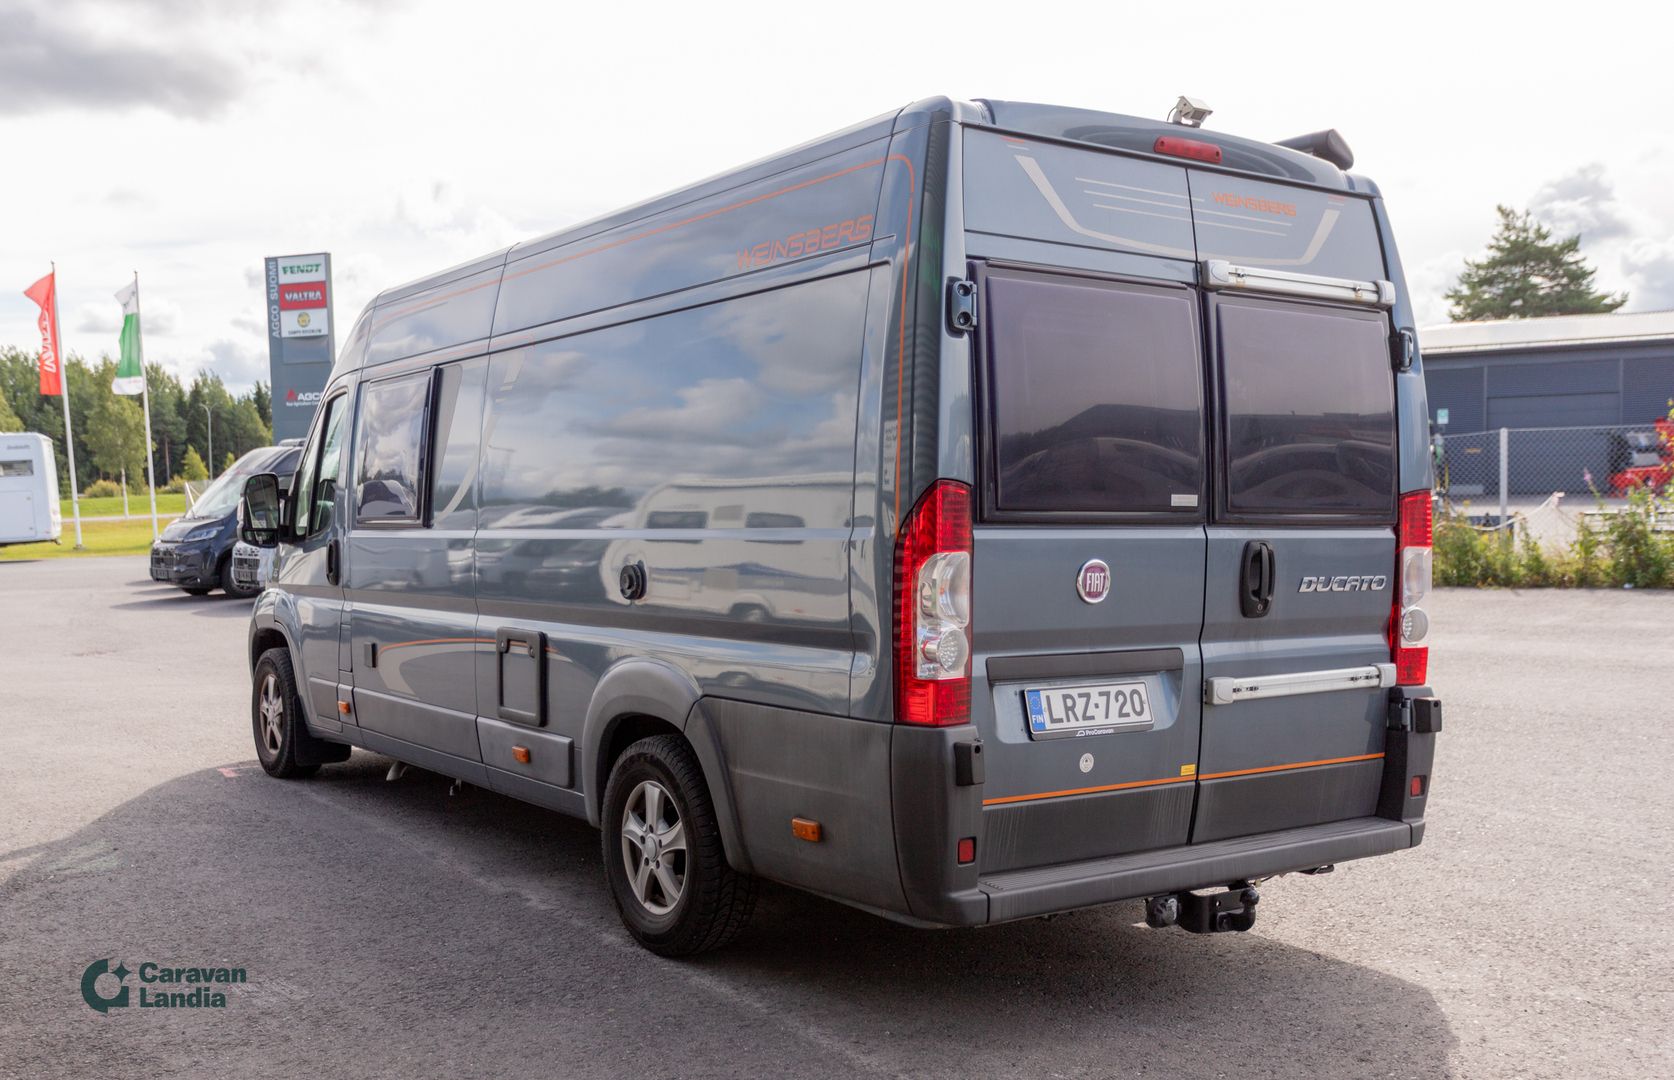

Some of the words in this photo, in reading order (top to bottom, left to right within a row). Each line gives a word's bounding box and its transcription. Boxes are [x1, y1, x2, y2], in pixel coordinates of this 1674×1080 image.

[736, 213, 874, 270] WEINSBERG
[282, 263, 322, 275] FENDT
[269, 261, 278, 300] SUOMI
[284, 290, 322, 302] VALTRA
[271, 305, 280, 338] AGCO
[1086, 572, 1105, 592] FIAT
[1298, 575, 1387, 592] DUCATO
[1045, 688, 1146, 724] LRZ-720
[1032, 715, 1045, 724] FIN
